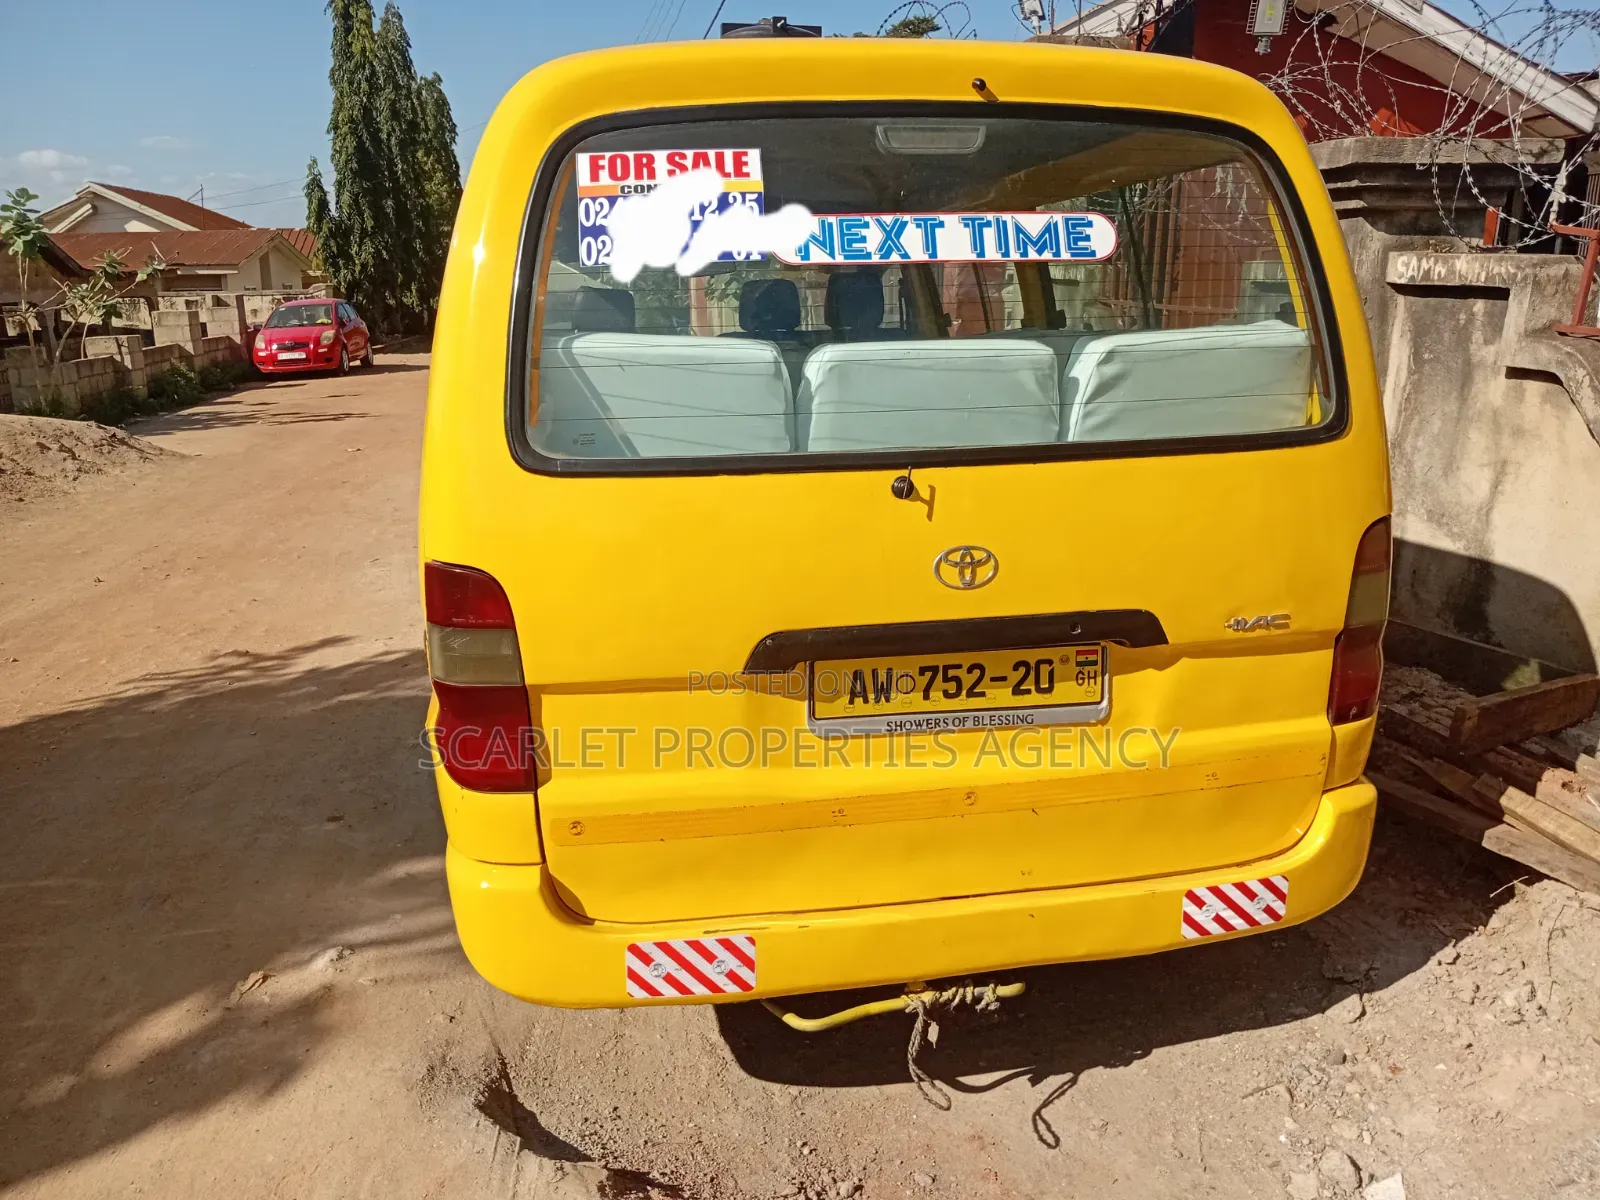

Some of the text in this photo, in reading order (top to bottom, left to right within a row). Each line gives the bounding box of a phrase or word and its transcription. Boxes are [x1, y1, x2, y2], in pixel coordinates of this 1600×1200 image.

[589, 150, 751, 182] FOR SALE
[619, 183, 659, 195] CON
[581, 234, 614, 266] 02
[796, 215, 1096, 261] NEXT TIME
[848, 658, 1055, 705] AW 752-20
[1075, 669, 1098, 687] GH
[886, 714, 1034, 732] SHOWERS OF BLESSING
